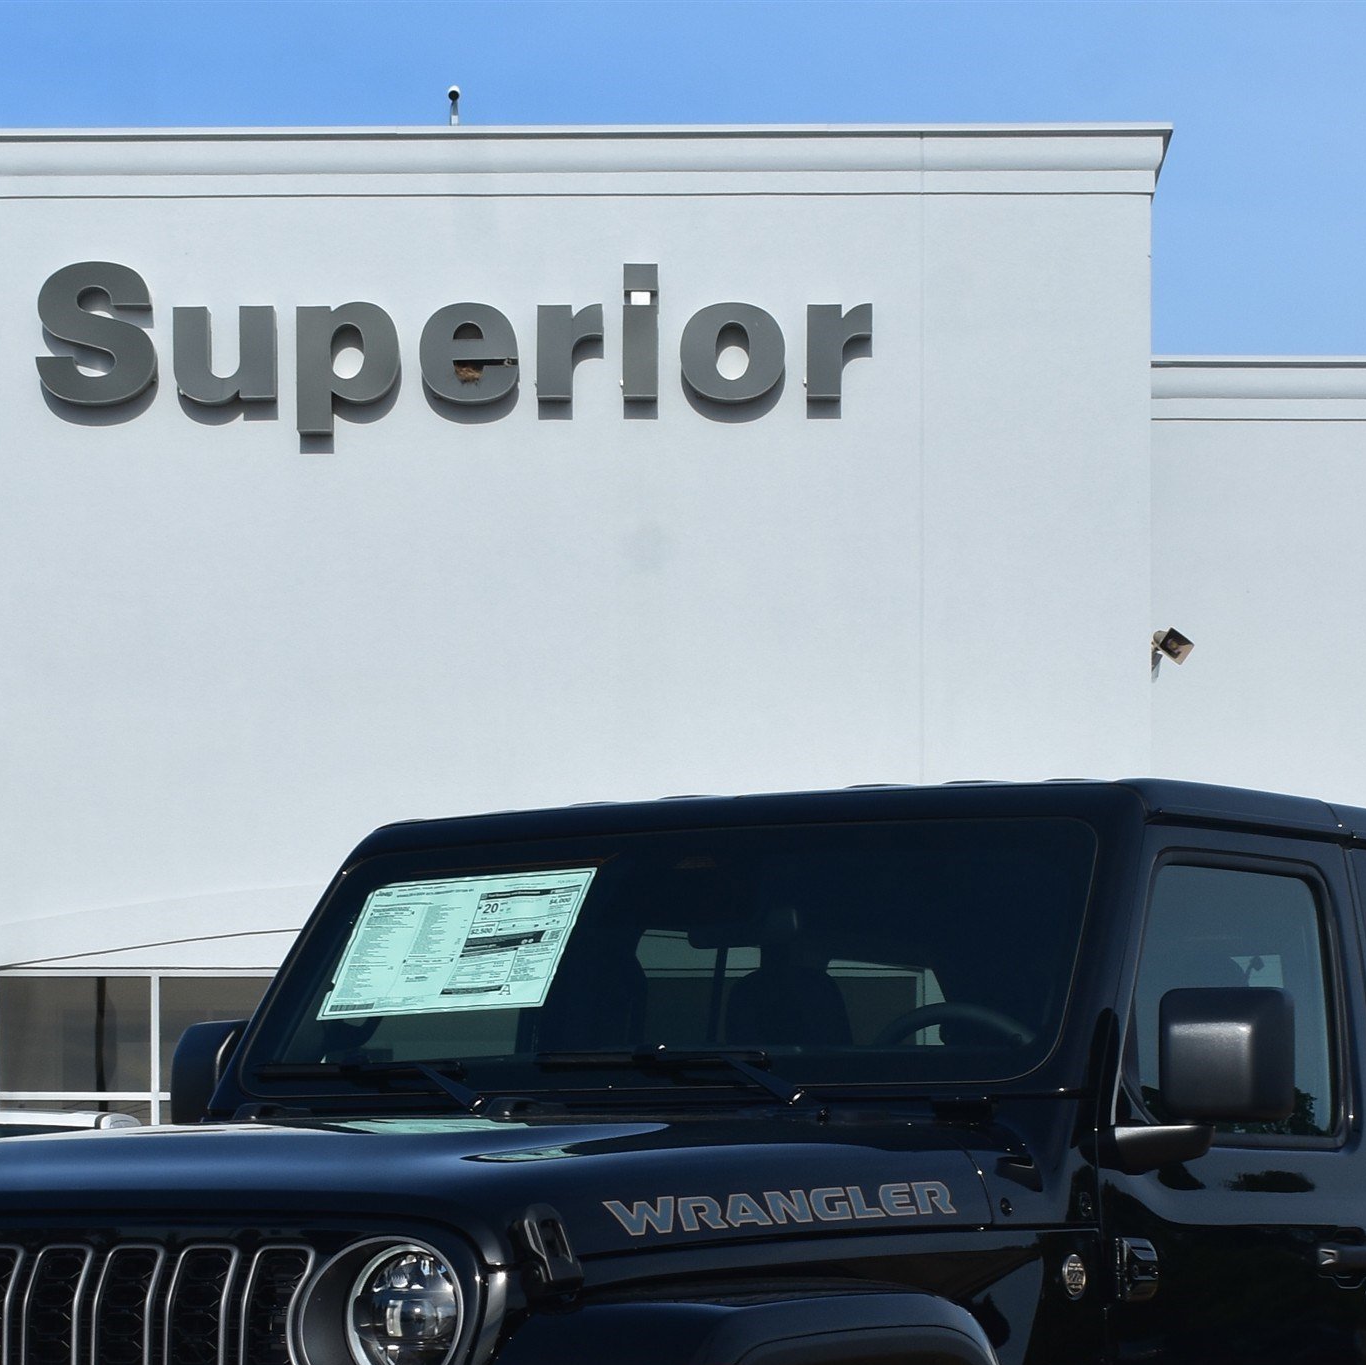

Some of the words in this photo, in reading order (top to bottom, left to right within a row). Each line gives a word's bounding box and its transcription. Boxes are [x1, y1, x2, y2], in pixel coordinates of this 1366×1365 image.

[35, 261, 873, 437] Superior
[483, 902, 499, 914] 20
[602, 1180, 957, 1236] WRANGLER
